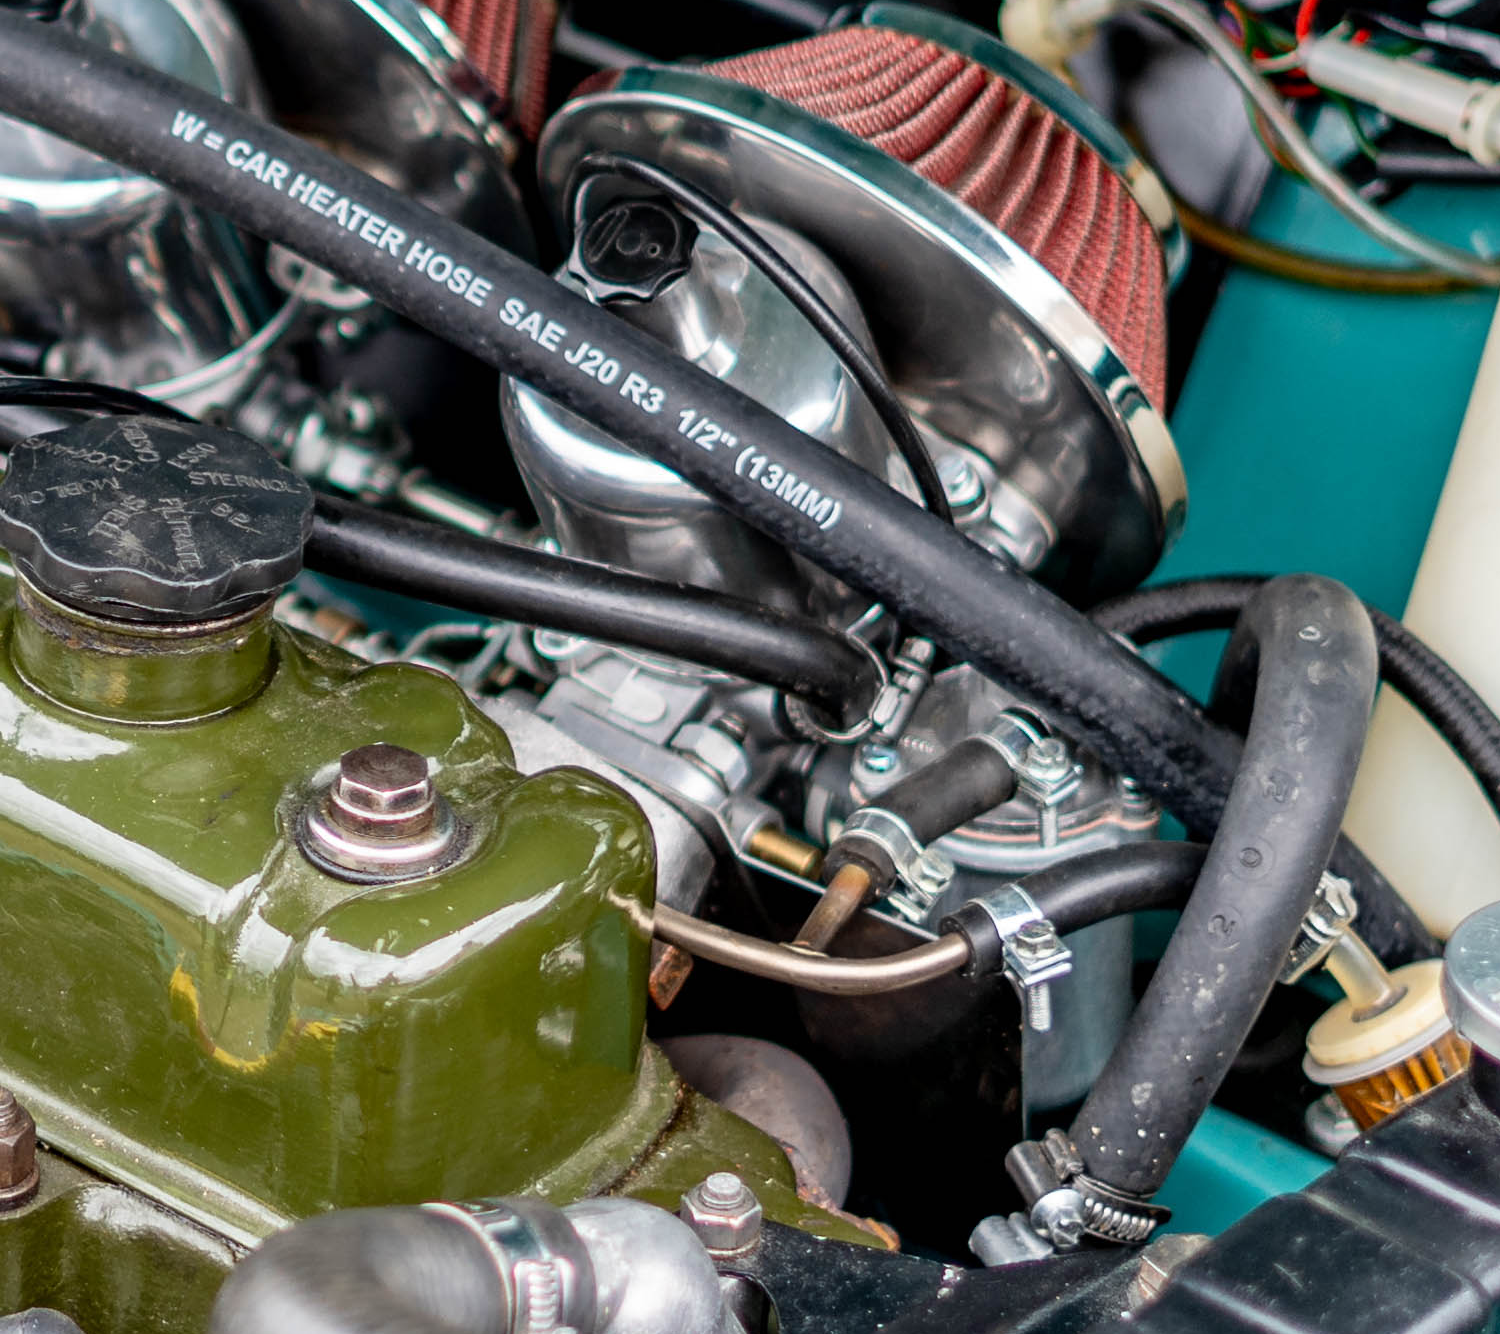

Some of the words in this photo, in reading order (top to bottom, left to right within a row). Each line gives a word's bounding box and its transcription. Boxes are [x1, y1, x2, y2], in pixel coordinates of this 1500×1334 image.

[171, 110, 207, 142] W
[225, 139, 290, 190] CAR
[288, 174, 408, 256] HEATER
[403, 240, 493, 307] HOSE
[499, 297, 567, 352] SAE
[564, 341, 622, 386] J20
[619, 371, 667, 414] R3
[676, 408, 738, 452] 1/2"
[733, 445, 844, 531] (13MM)
[166, 442, 218, 469] ESSO
[46, 475, 123, 500] MOBIL
[188, 470, 304, 495] STERNOL
